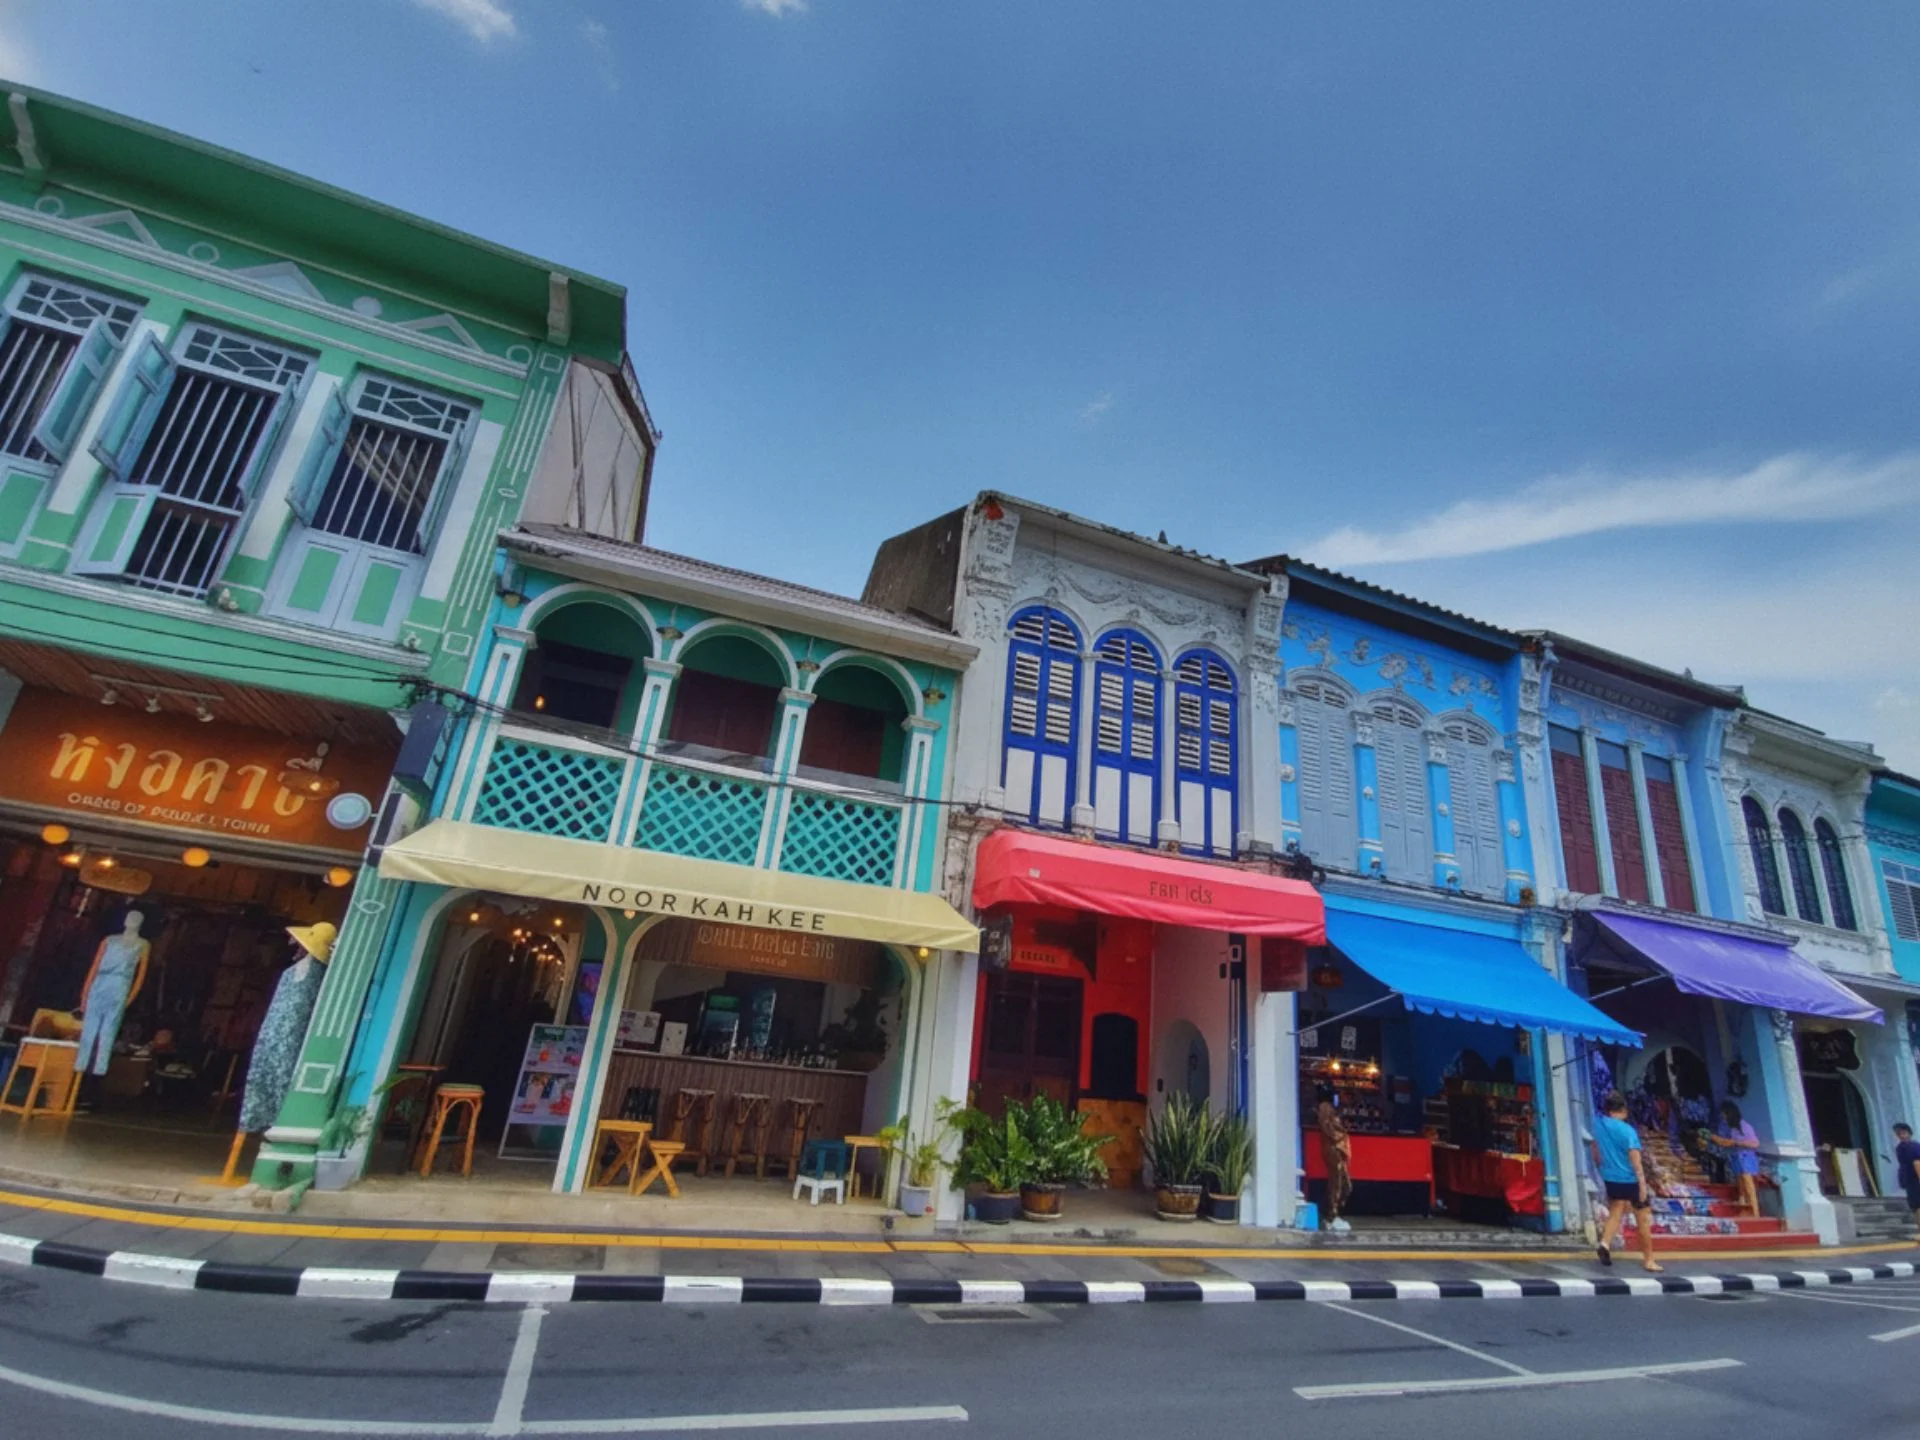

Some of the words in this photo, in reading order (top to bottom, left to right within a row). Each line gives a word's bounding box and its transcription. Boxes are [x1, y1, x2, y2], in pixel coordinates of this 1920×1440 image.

[582, 884, 677, 912] NOOR
[691, 897, 754, 923] KAH
[768, 908, 827, 931] KEE
